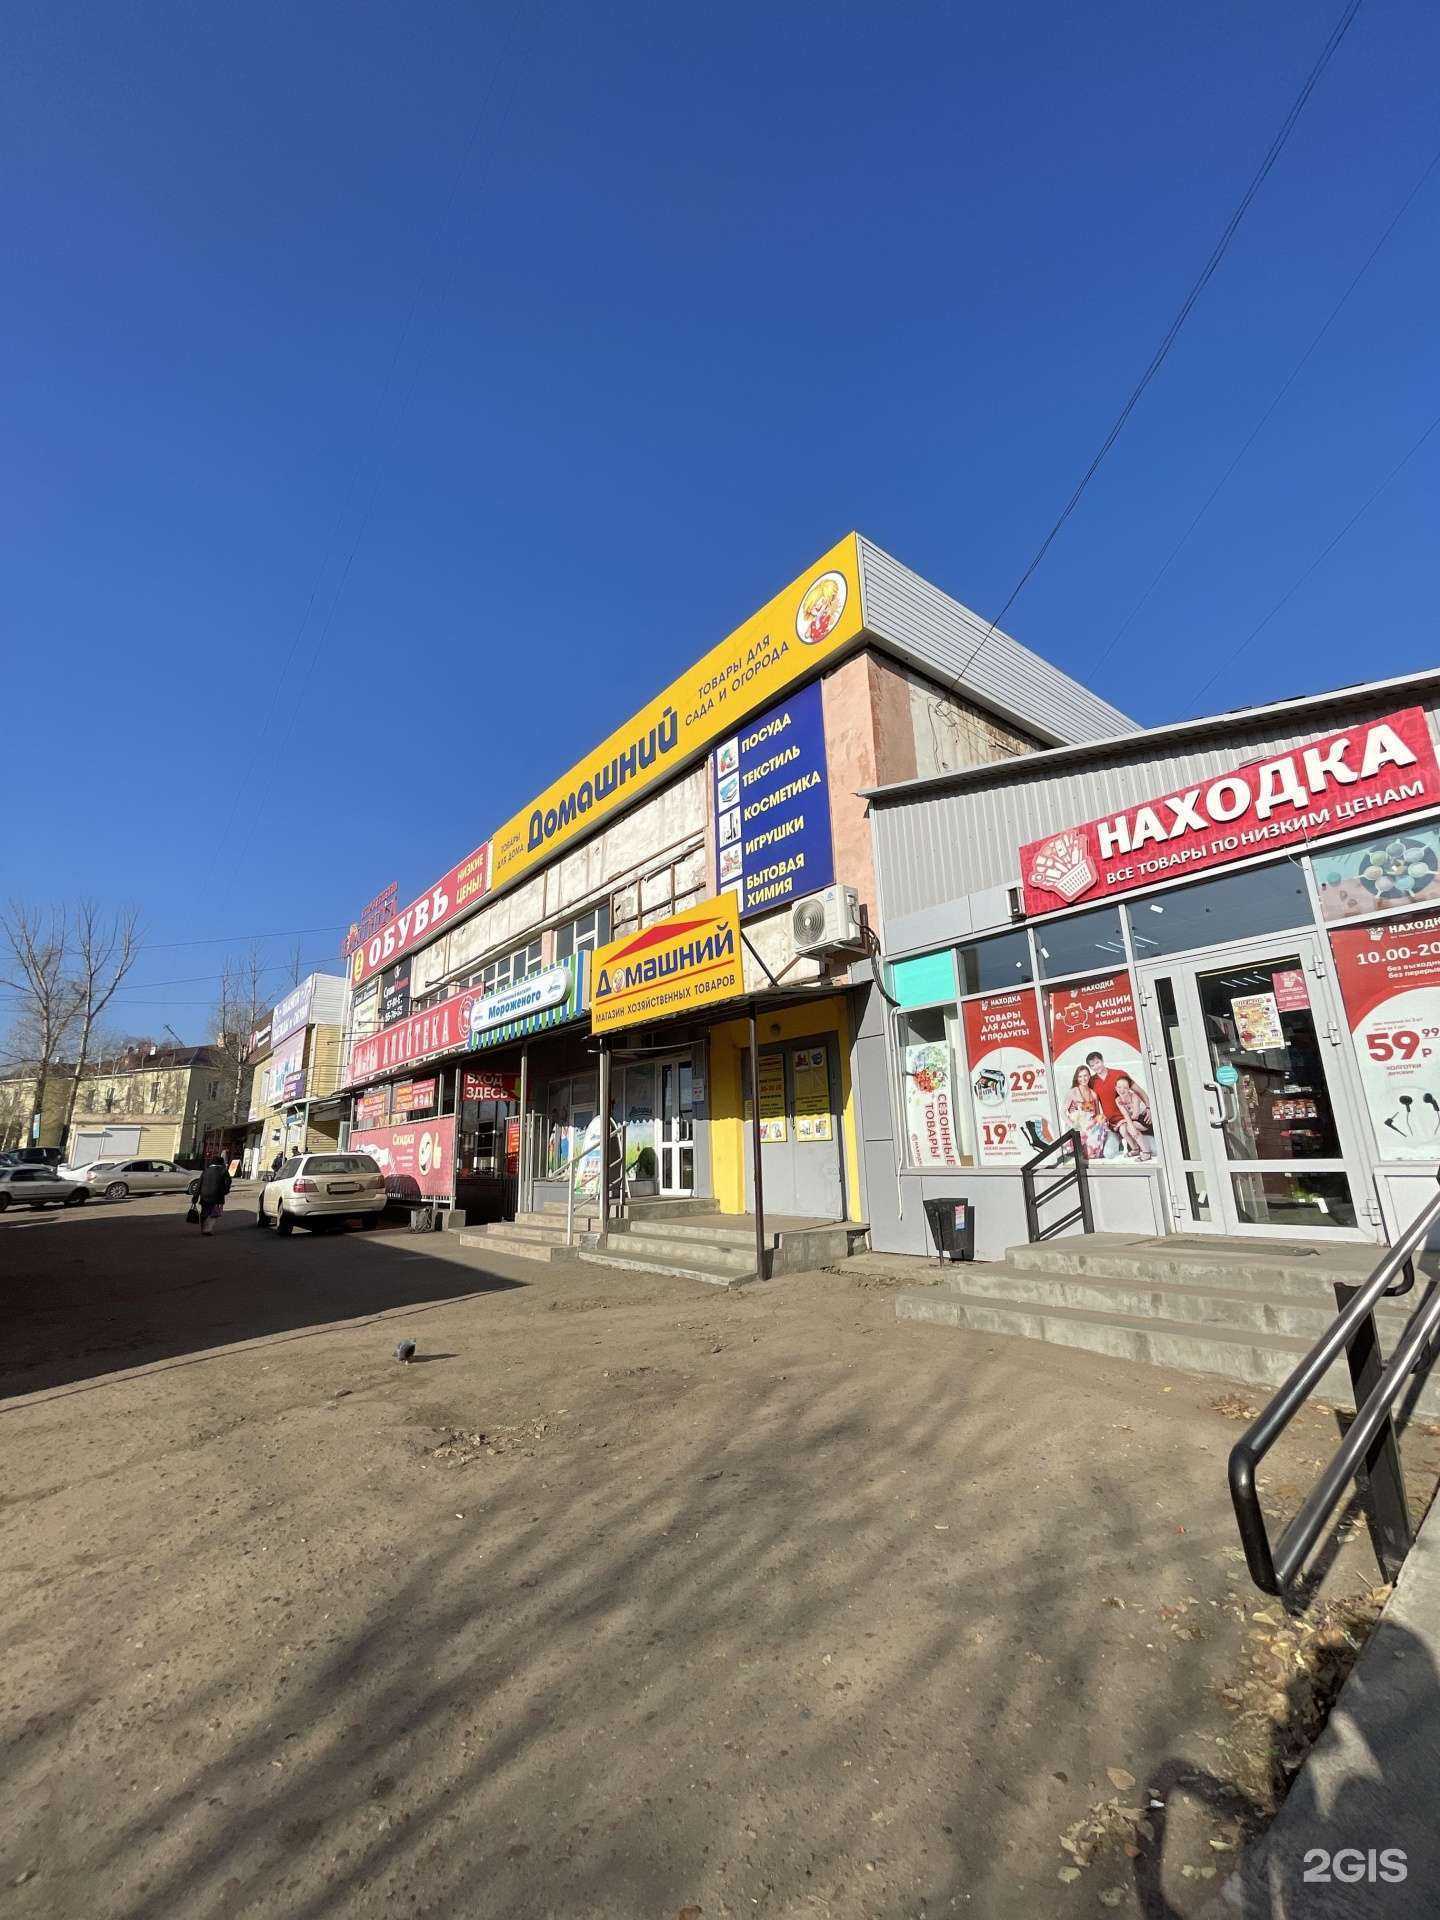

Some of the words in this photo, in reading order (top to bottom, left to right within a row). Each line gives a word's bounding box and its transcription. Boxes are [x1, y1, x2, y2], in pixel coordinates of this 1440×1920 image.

[698, 658, 742, 699] ТОВАРЫ
[746, 634, 771, 665] ДЛЯ
[685, 698, 714, 726] САДА
[719, 690, 727, 703] И
[731, 641, 789, 692] ОГОРОДА
[740, 712, 792, 753] ПОСУДА
[527, 706, 678, 853] Домашний
[742, 744, 801, 787] ТЕКСТИЛЬ
[743, 770, 822, 822] КОСМЕТИКА
[1096, 723, 1418, 860] НАХОДКА
[745, 816, 805, 855] ИГРУШКИ
[1105, 867, 1135, 886] ВСЕ
[1136, 846, 1207, 874] ТОВАРЫ
[1210, 835, 1239, 855] ПО
[1240, 810, 1331, 844] НИЗКИМ
[1336, 780, 1425, 821] ЦЕНАМ
[457, 852, 484, 881] НИЗКИЕ
[508, 844, 525, 862] ДОМА
[746, 853, 805, 890] БЫТОВАЯ
[456, 873, 484, 904] ЦЕНЫ!
[747, 877, 793, 908] ХИМИЯ
[368, 887, 449, 968] ОБУВЬ
[595, 921, 735, 998] Домашний
[595, 1007, 625, 1024] МАГАЗИН
[627, 988, 691, 1014] ХОЗЯЙСТВЕННЫХ
[694, 974, 736, 996] ТОВАРОВ
[990, 995, 1022, 1006] НАХОДКА
[1081, 979, 1115, 993] НАХОДКА
[1094, 994, 1131, 1010] АКЦИИ
[488, 989, 541, 1020] Мороженого
[984, 1011, 1021, 1023] ТОВАРЫ
[1095, 1017, 1120, 1026] КАЖДЫЙ
[1120, 1015, 1134, 1023] ДЕНЬ
[1100, 1005, 1133, 1018] СКИДКИ
[383, 1010, 449, 1068] АЛКОТЕКА
[980, 1034, 986, 1042] И
[988, 1029, 1030, 1041] ПРОДУКТЫ
[981, 1023, 999, 1033] ДЛЯ
[1001, 1019, 1027, 1030] ДОМА
[1366, 1031, 1420, 1062] 59
[1422, 1028, 1440, 1038] 99
[466, 1073, 503, 1086] ВХОД
[466, 1086, 508, 1100] ЗДЕСЬ
[1010, 1071, 1036, 1091] 29
[1036, 1069, 1045, 1077] 99
[925, 1104, 940, 1158] ТОВАРЫ
[938, 1093, 956, 1165] СЕЗОННЫЕ
[983, 1124, 1008, 1144] 19
